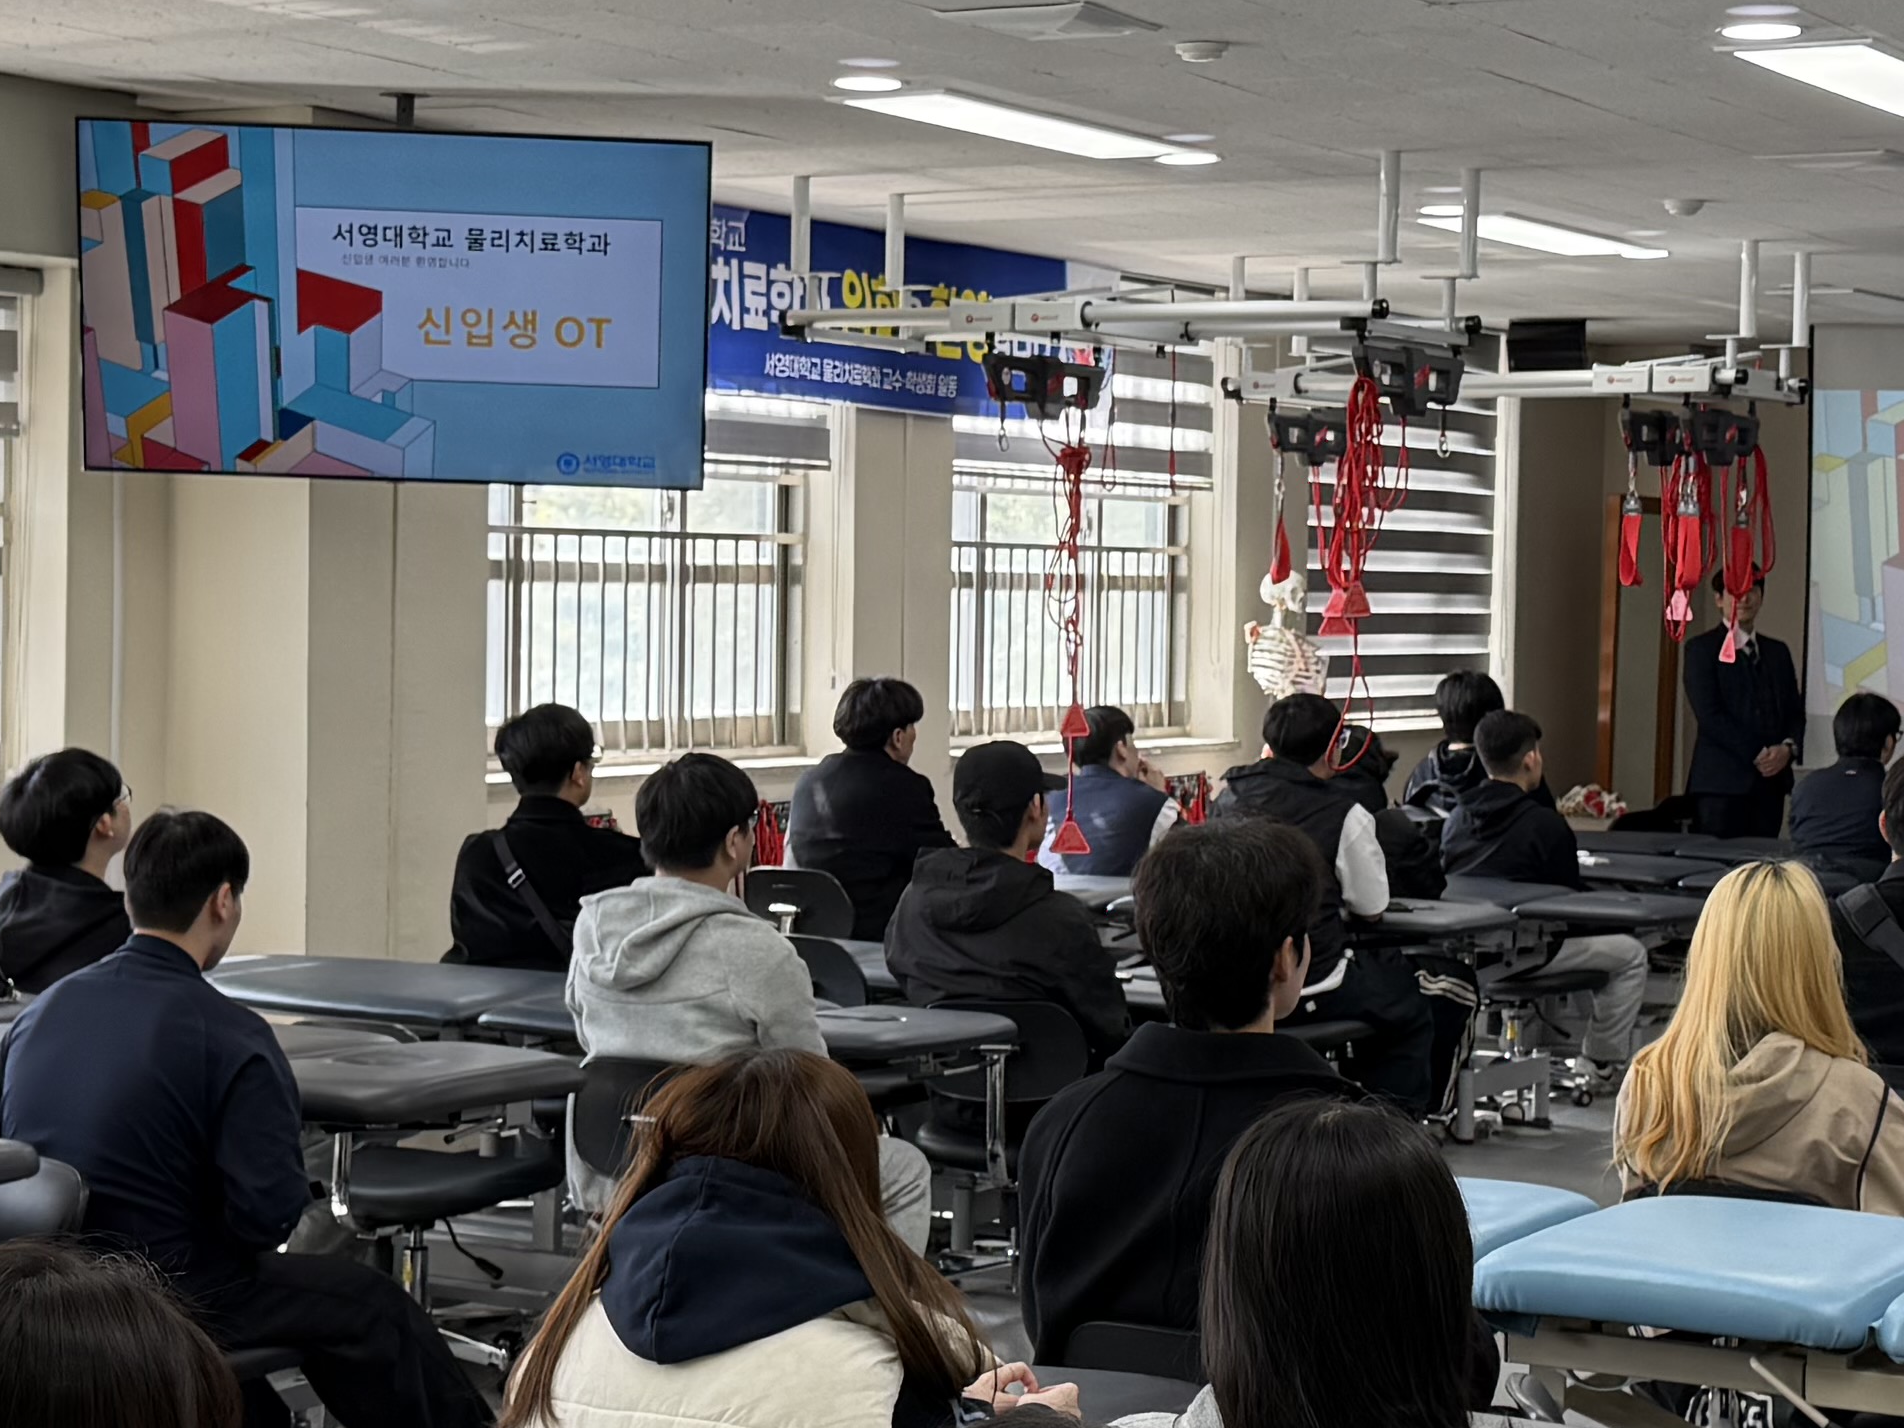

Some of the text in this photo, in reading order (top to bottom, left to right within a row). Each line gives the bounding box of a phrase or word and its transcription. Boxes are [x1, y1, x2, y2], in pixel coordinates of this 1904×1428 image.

[332, 222, 612, 257] 서영대학교 물리치료학과
[417, 306, 613, 350] 신입생 OT
[763, 351, 823, 382] 서영대학교
